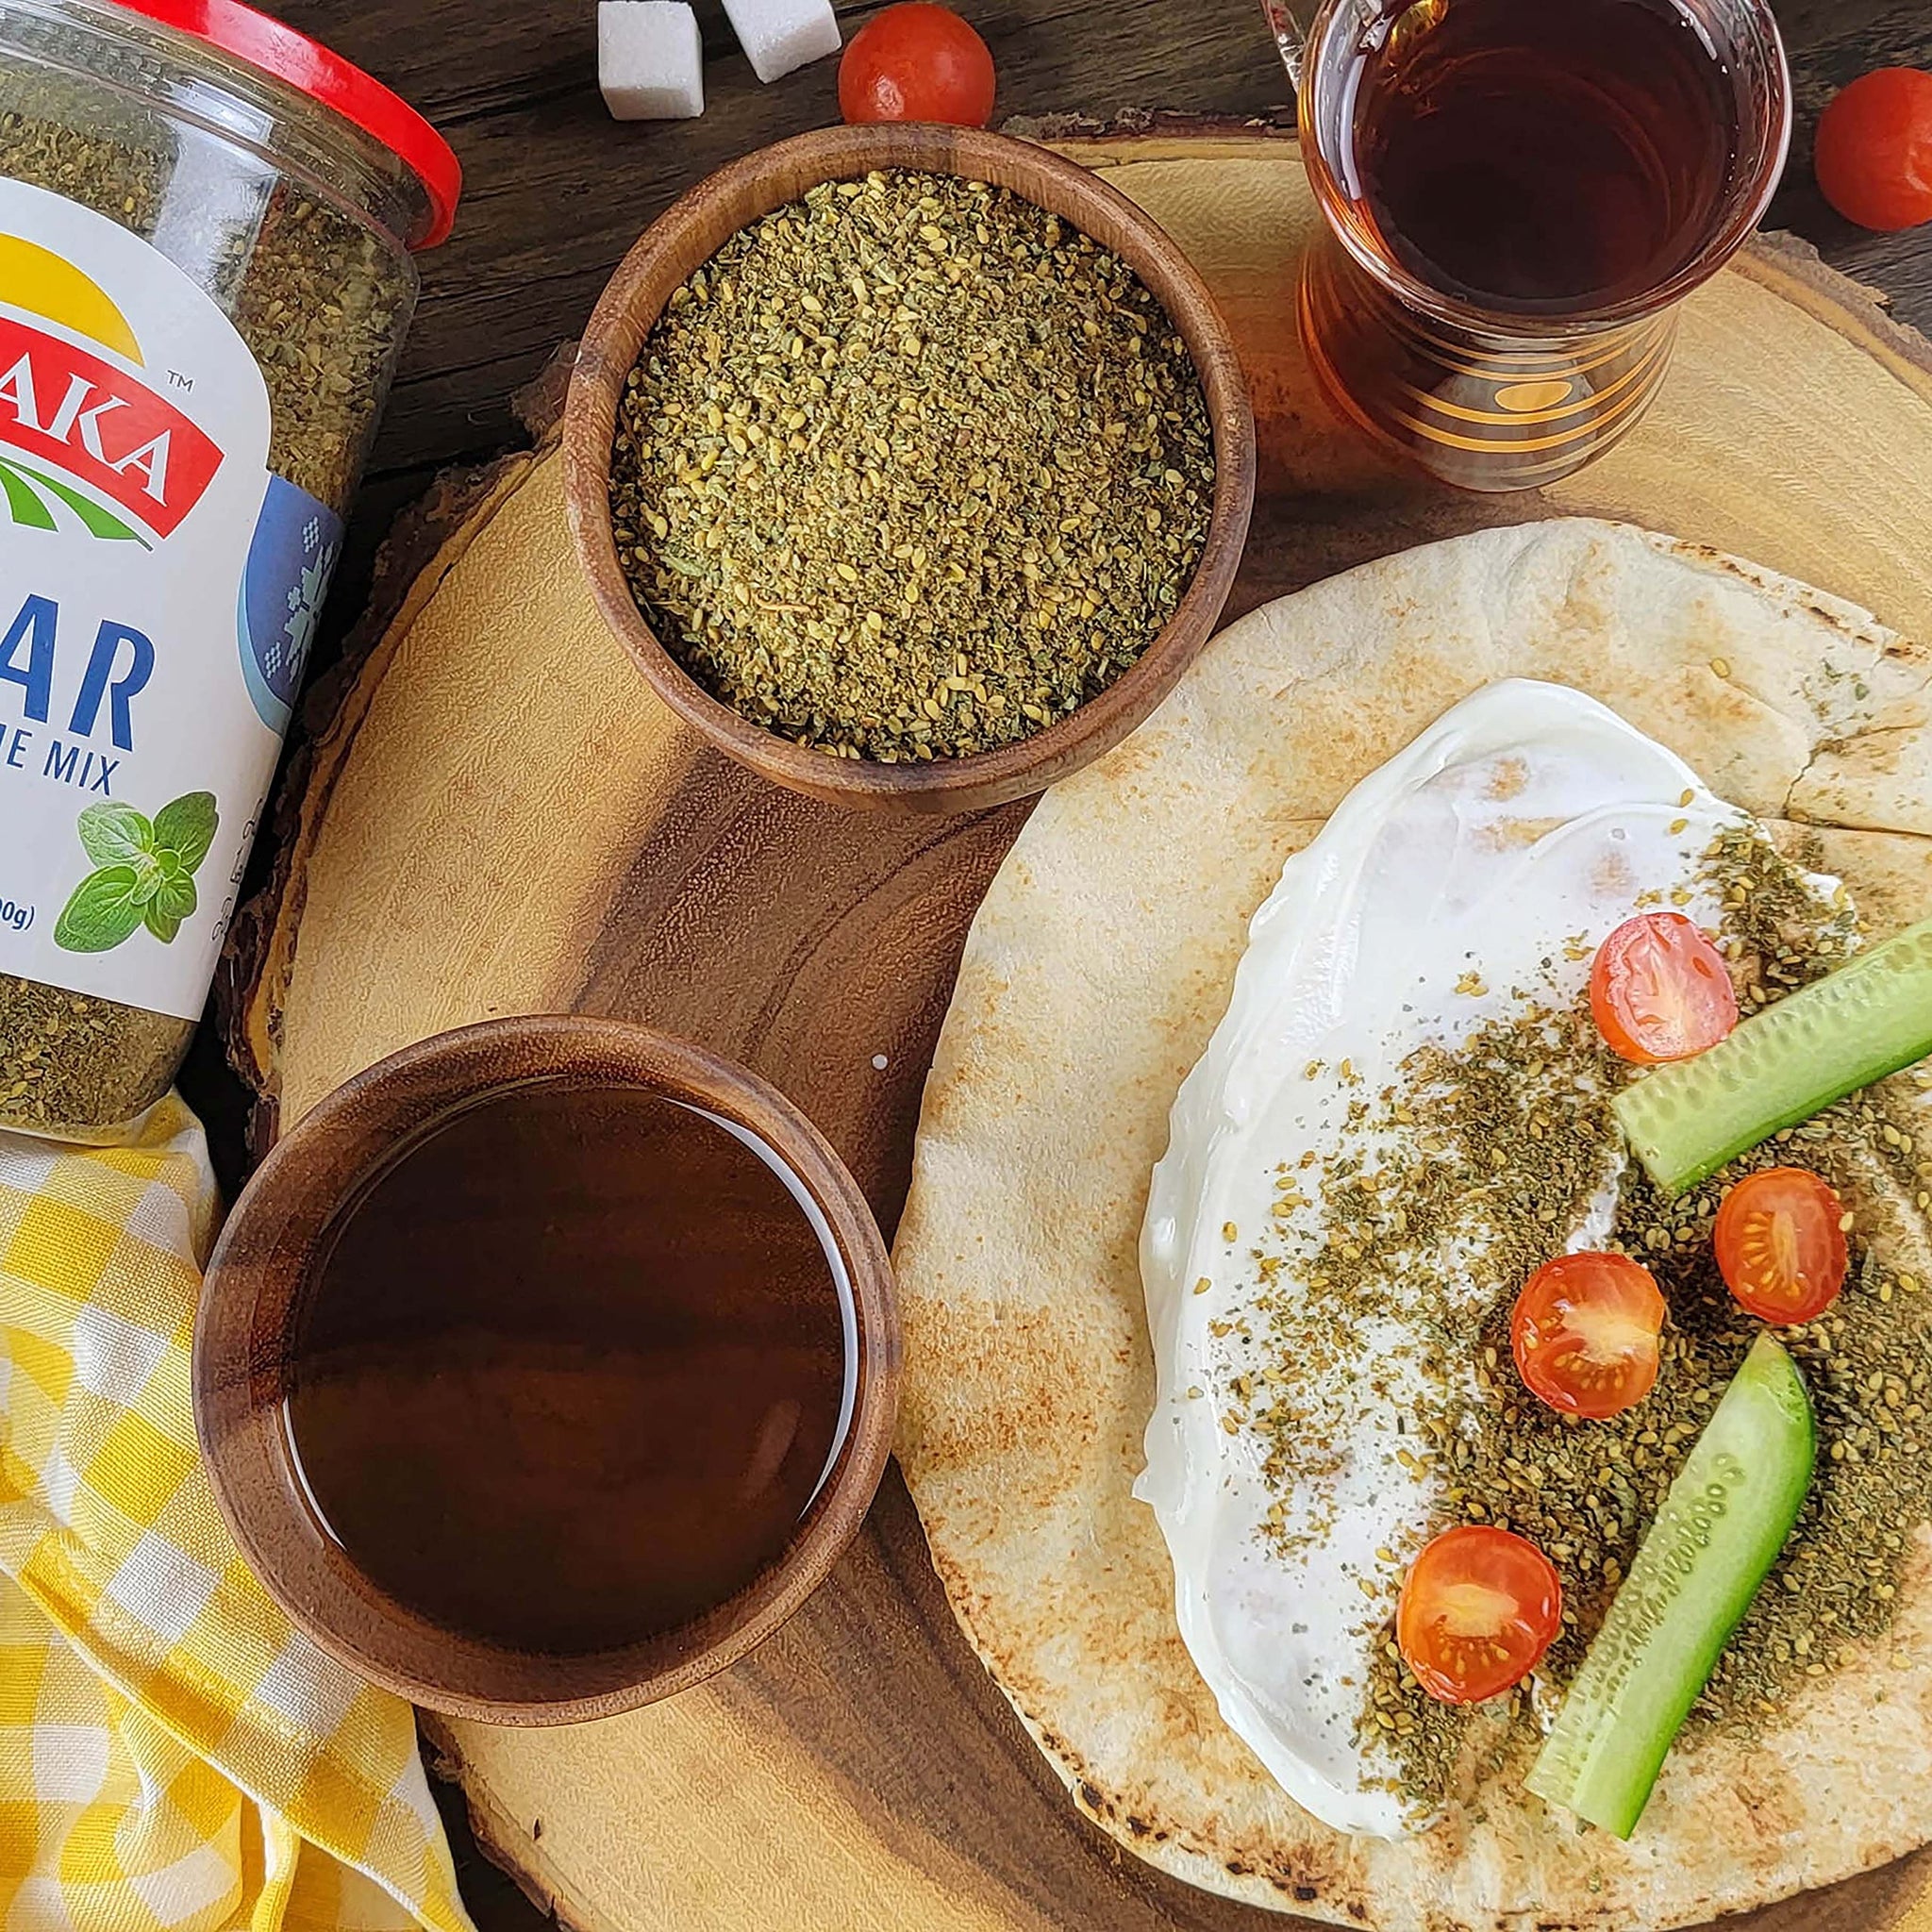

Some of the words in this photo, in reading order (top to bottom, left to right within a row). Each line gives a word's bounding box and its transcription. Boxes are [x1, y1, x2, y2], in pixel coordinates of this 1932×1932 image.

[167, 369, 193, 392] TM
[0, 351, 171, 508] AKA
[0, 593, 155, 752] AR
[0, 724, 33, 769] E
[42, 740, 120, 796] MIX
[0, 898, 35, 930] 0g)
